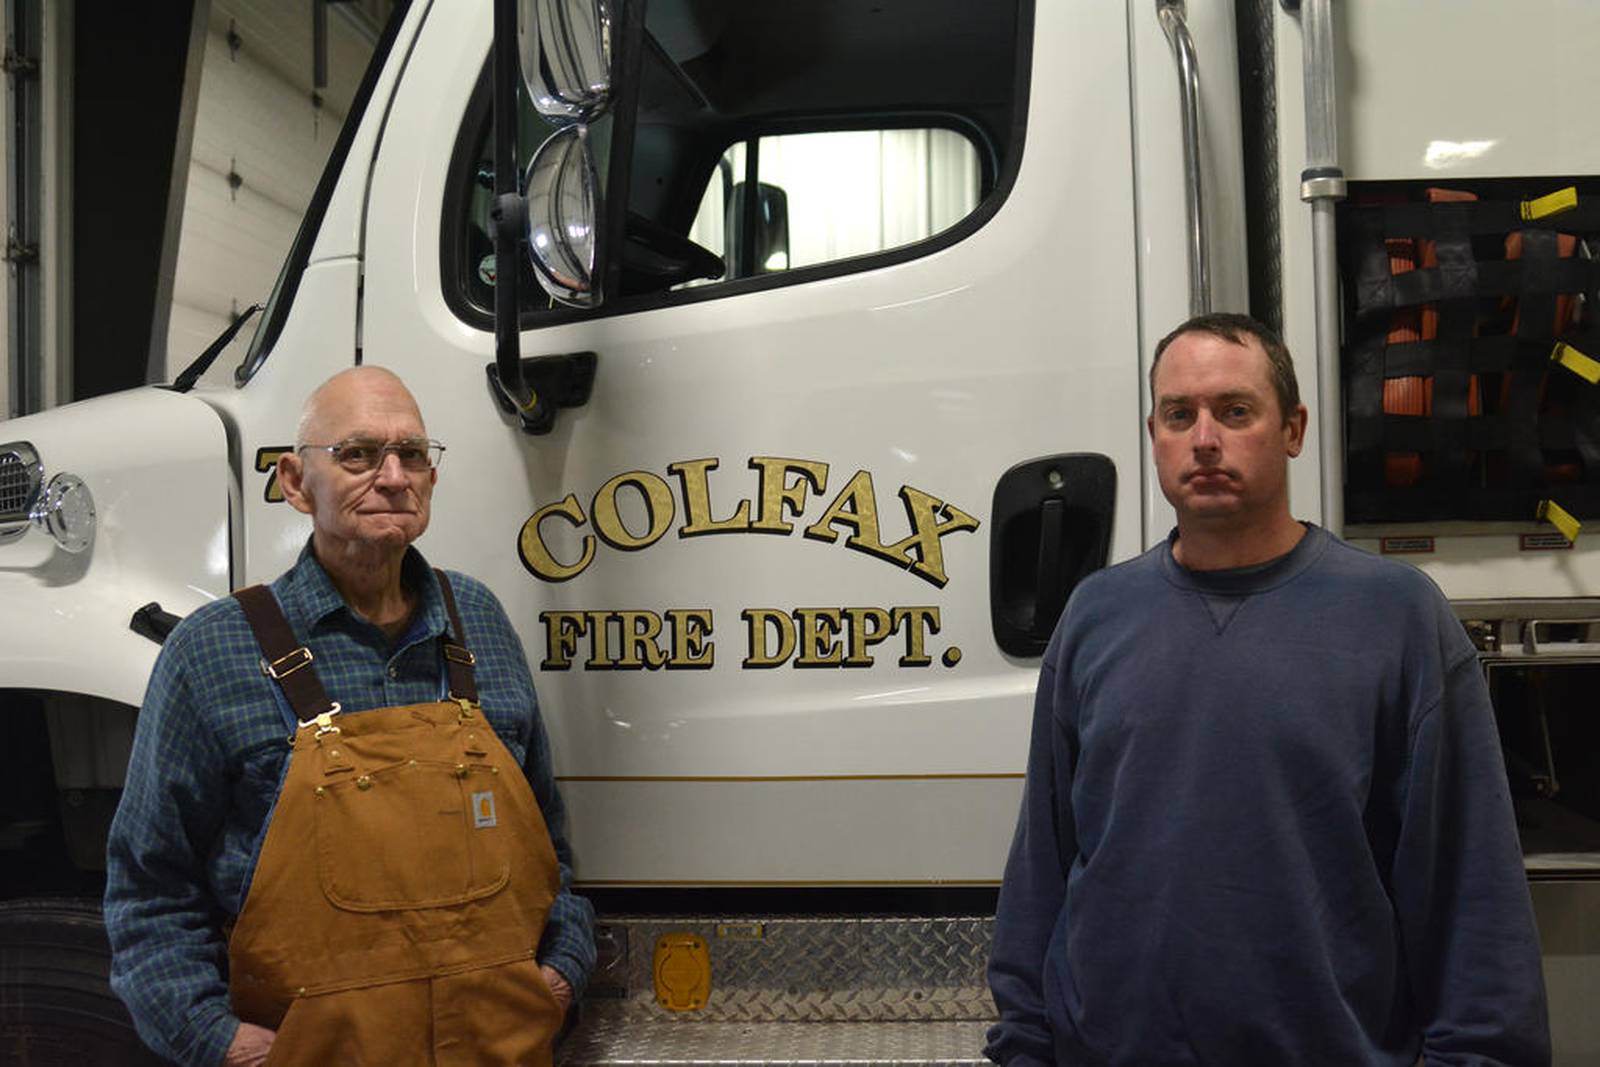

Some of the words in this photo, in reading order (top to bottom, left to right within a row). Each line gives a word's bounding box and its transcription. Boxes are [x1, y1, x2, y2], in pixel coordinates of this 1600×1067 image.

[517, 456, 980, 589] COLFAX
[540, 609, 714, 670] FIRE
[741, 606, 962, 669] DEPT.
